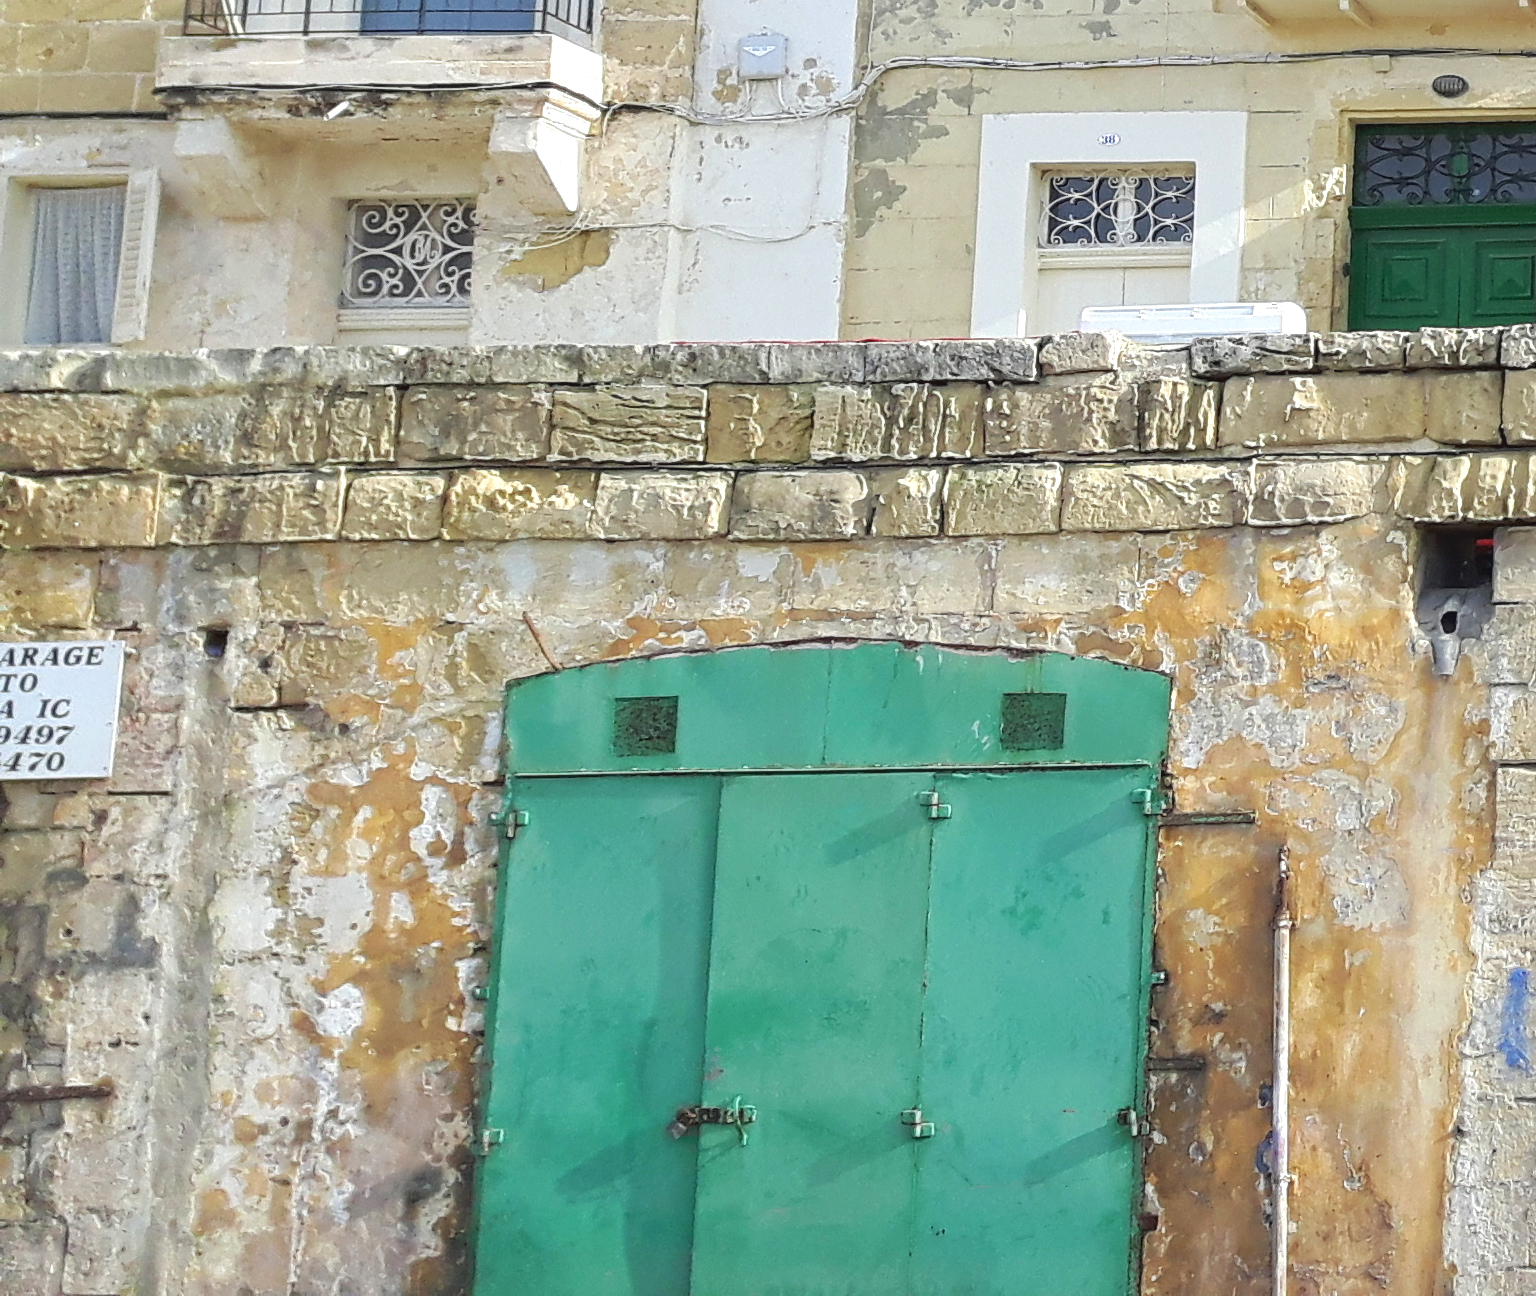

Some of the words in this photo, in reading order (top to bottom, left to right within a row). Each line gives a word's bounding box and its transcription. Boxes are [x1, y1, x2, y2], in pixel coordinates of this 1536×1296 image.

[1101, 135, 1116, 145] 38
[36, 698, 71, 719] IC
[0, 751, 65, 772] 470
